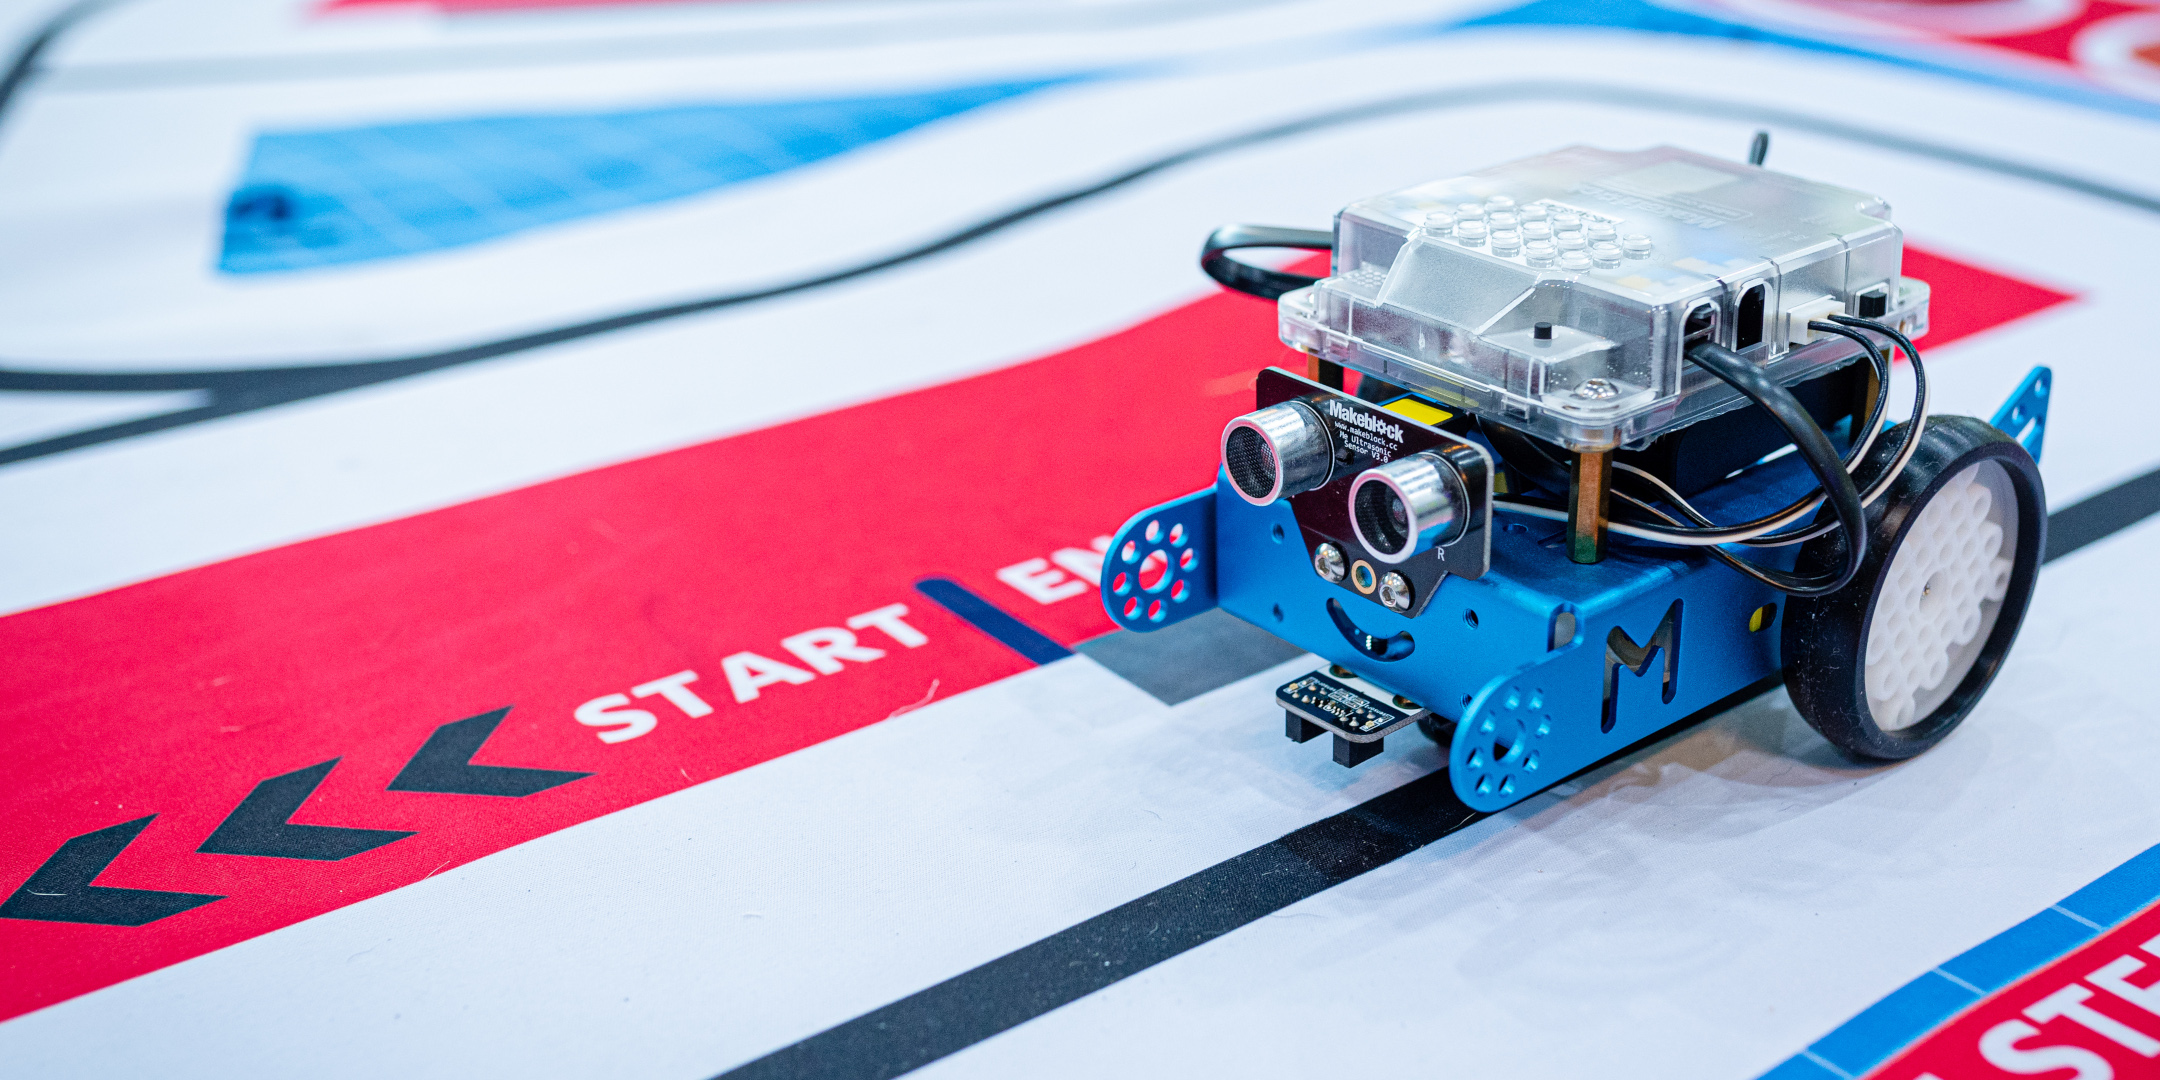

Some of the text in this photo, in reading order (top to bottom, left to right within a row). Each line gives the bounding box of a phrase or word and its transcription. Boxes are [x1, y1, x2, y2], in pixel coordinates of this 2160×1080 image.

[1329, 399, 1404, 444] Makeblock
[1334, 421, 1398, 451] www.makeblock.cc
[1339, 430, 1392, 458] Me Ultrasonic
[1344, 440, 1389, 464] Sensor V3.0
[1437, 546, 1446, 562] R
[573, 602, 929, 744] START
[1600, 597, 1685, 734] M
[1977, 932, 2160, 1080] STE
